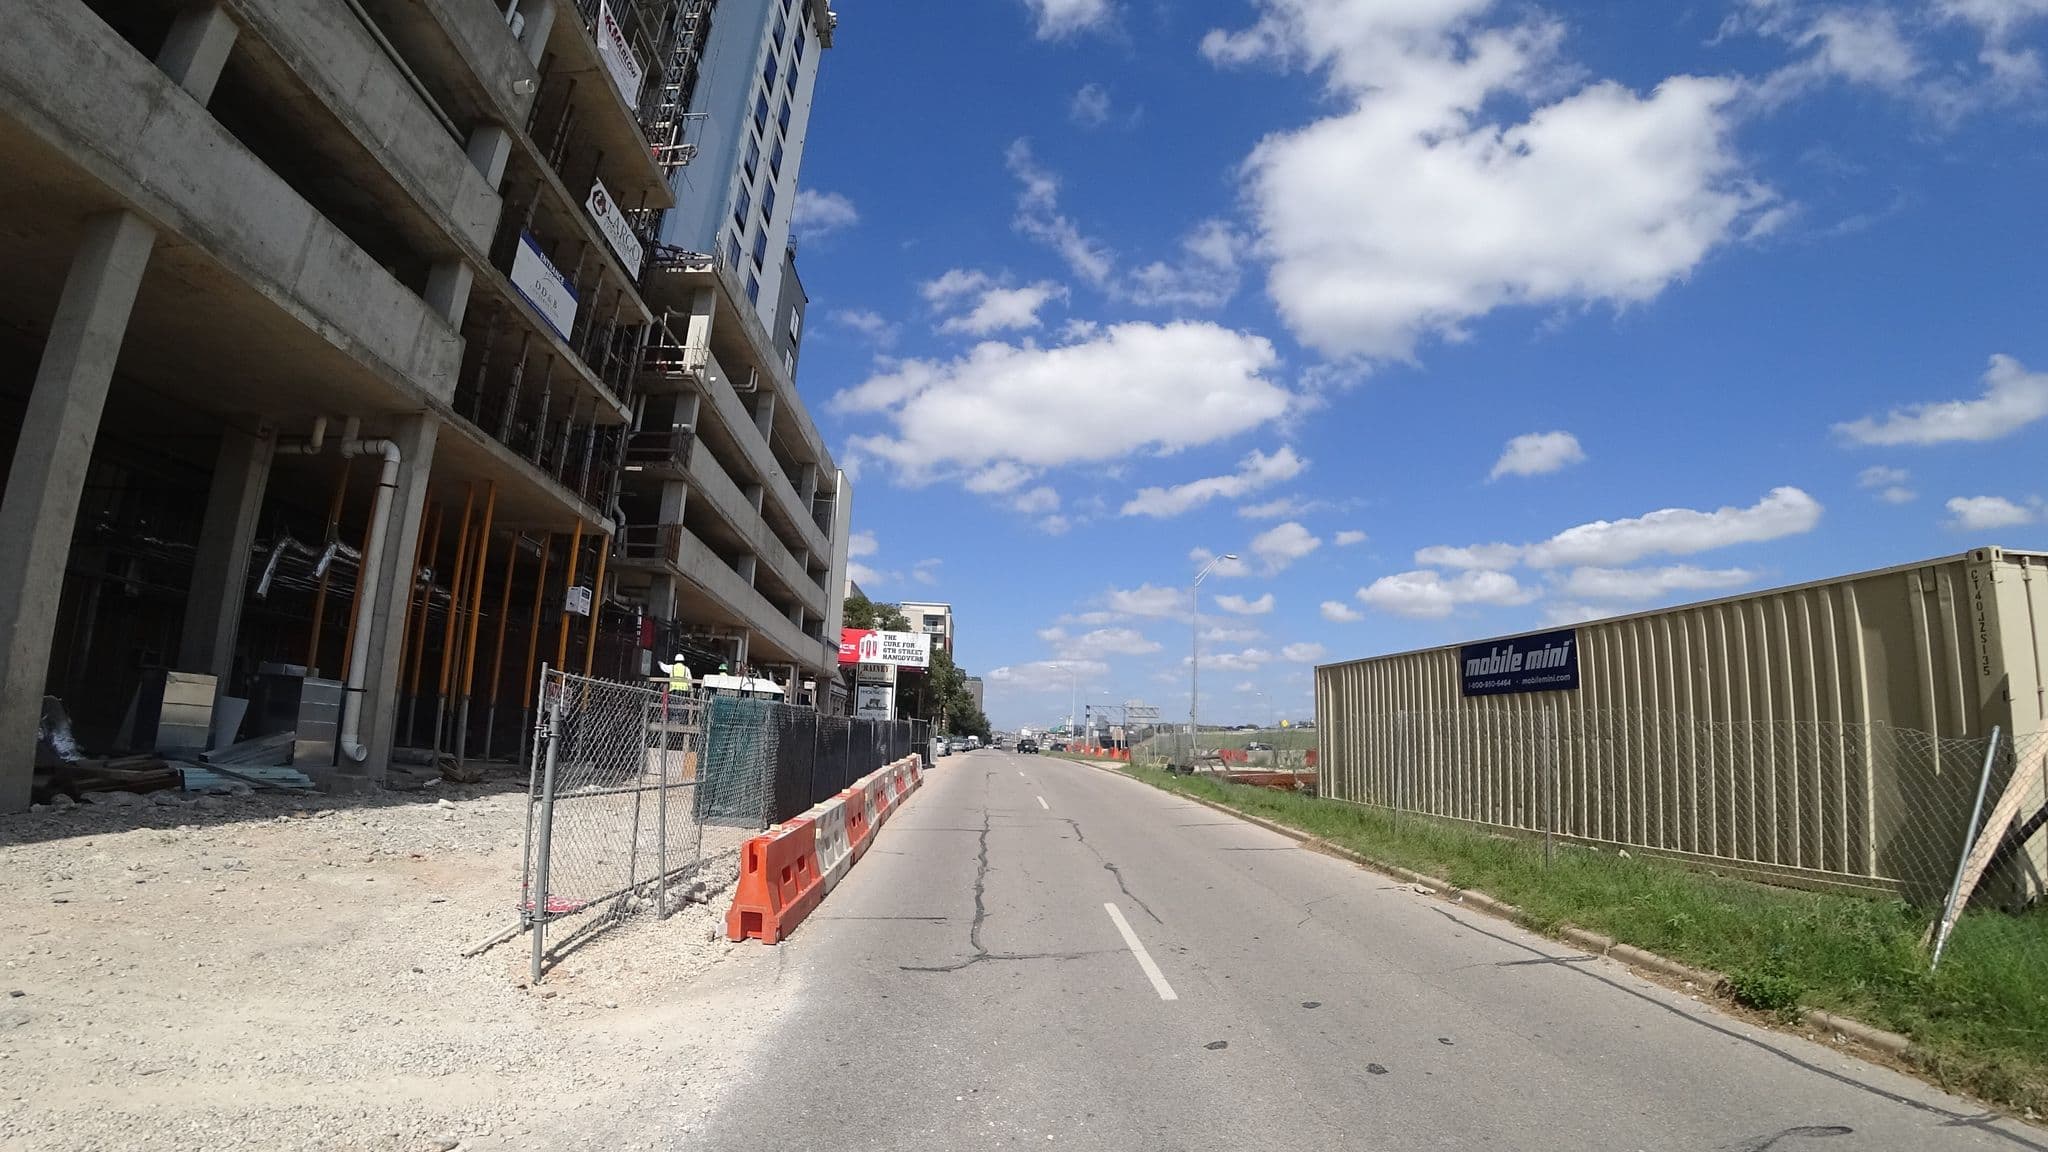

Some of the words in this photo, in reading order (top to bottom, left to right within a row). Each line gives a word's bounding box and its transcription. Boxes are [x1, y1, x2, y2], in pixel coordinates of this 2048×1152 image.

[606, 202, 641, 262] LARGO
[540, 251, 566, 286] ENTRANCE
[882, 654, 924, 663] HANGOVERS
[898, 648, 924, 656] STREET
[1465, 644, 1523, 677] mobile
[1525, 640, 1570, 671] mini
[1521, 674, 1571, 685] mobilemini.com
